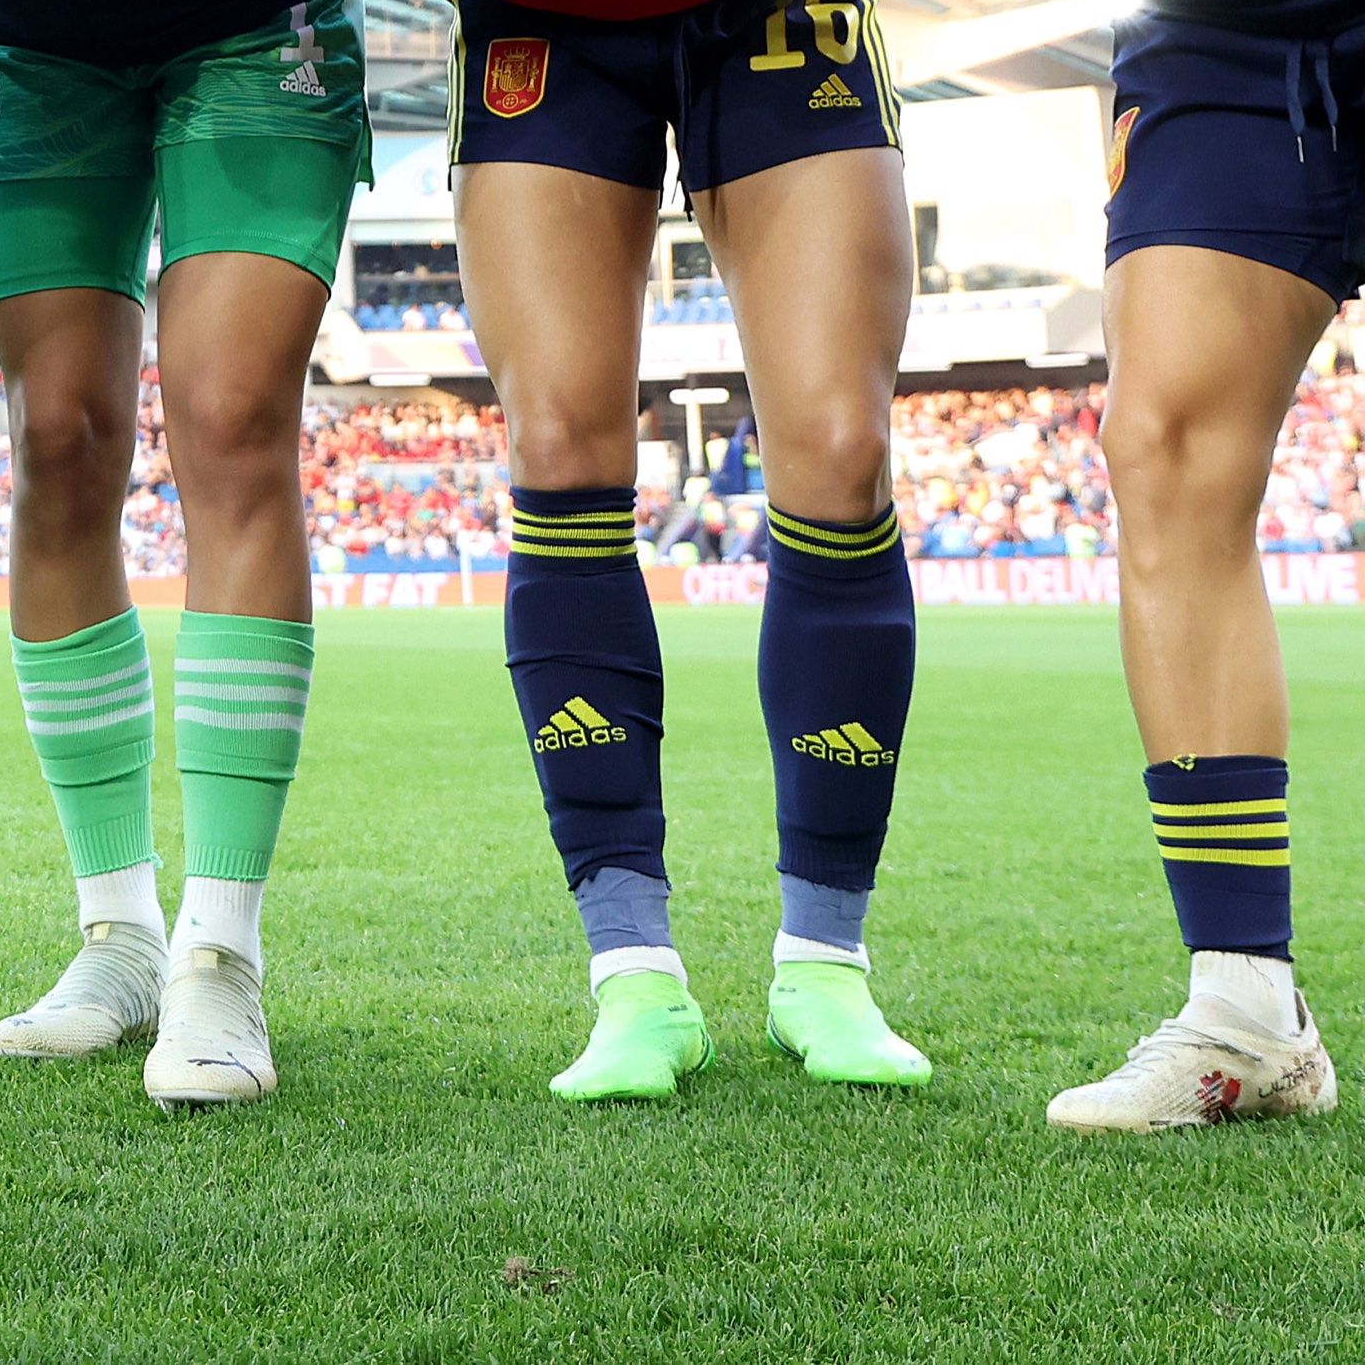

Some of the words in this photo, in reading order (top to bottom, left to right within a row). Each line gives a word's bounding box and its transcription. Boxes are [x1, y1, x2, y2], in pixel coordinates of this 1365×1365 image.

[279, 79, 327, 97] adidas
[808, 95, 862, 110] adidas
[311, 572, 357, 607] ST
[362, 572, 448, 607] EAT
[682, 564, 768, 605] OFFIC
[920, 559, 1007, 604] BALL
[533, 725, 628, 754] adidas
[790, 736, 895, 767] adidas
